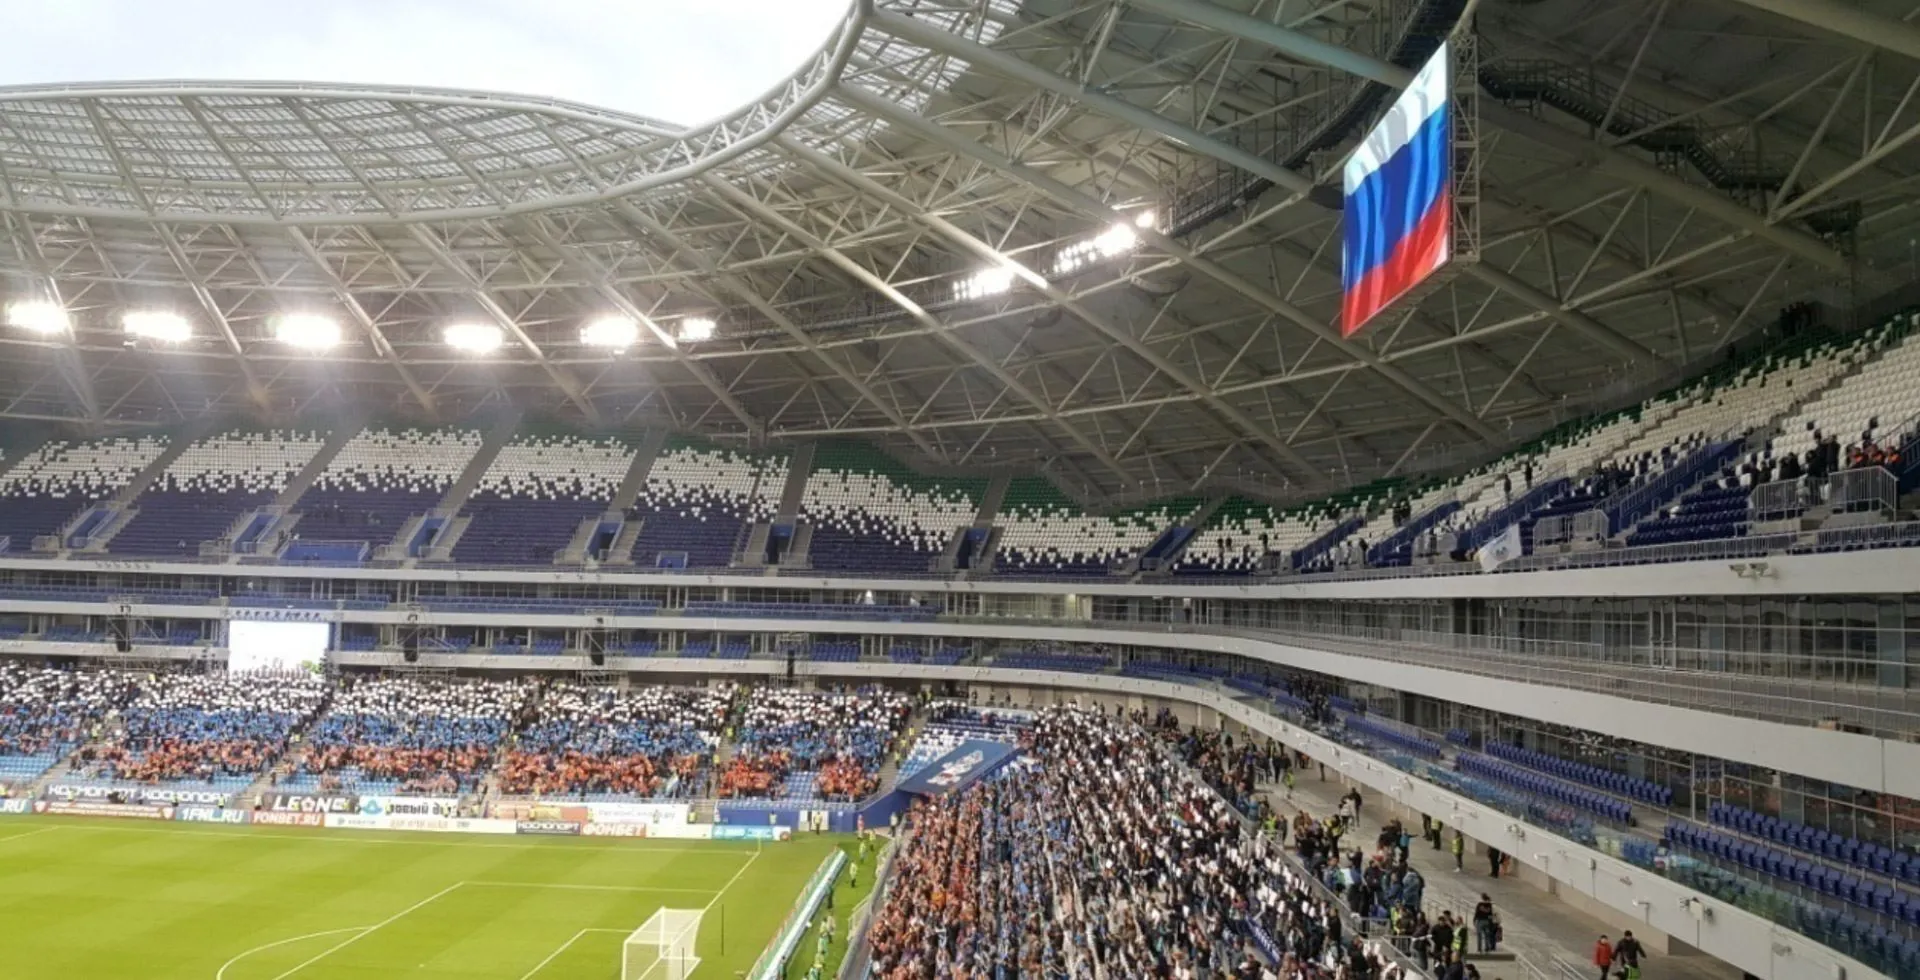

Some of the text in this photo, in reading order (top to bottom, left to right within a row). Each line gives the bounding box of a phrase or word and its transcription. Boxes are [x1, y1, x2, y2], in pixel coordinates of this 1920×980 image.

[182, 807, 244, 823] 1FNL.RU
[253, 811, 321, 826] FONBET.RU
[582, 821, 643, 837] ФОНБЕТ
